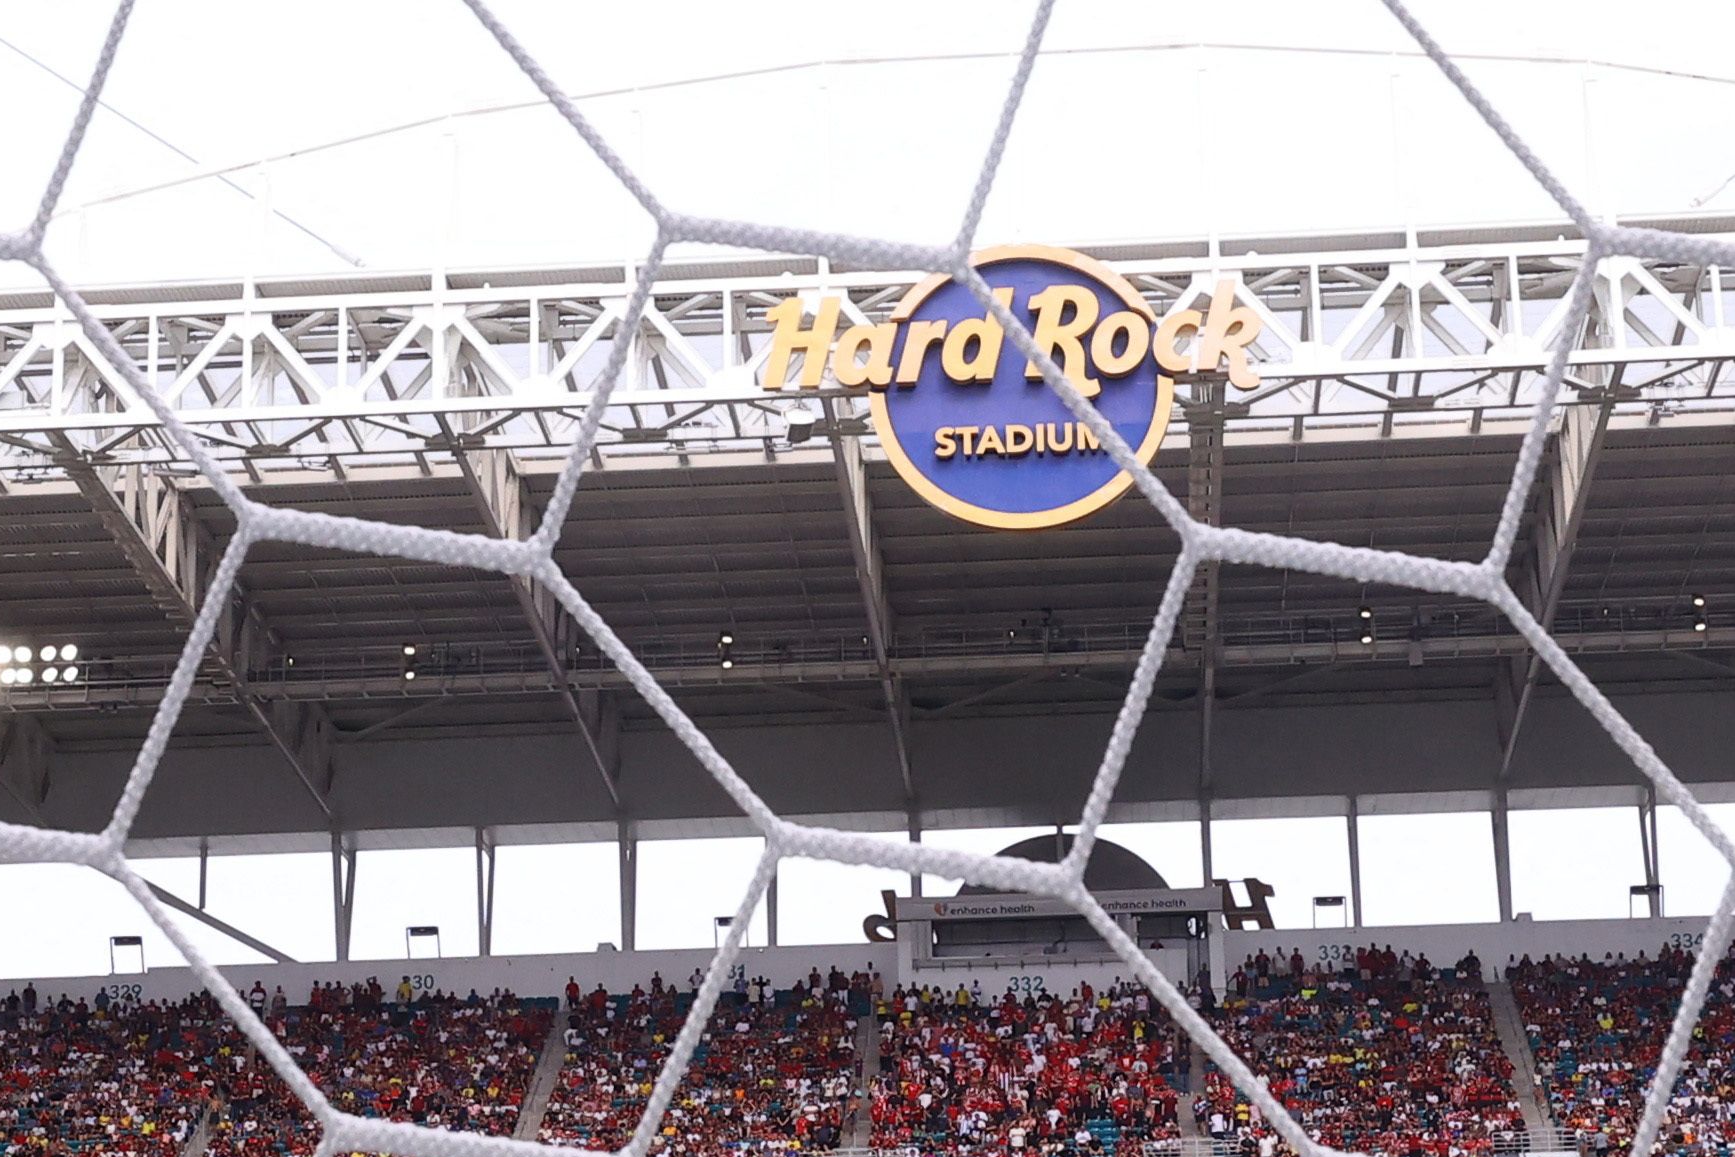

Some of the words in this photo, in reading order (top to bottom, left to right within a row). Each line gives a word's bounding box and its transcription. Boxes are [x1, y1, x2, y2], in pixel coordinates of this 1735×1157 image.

[763, 286, 1014, 391] Hard
[1023, 279, 1263, 398] Rock
[950, 904, 997, 916] enhance
[1001, 902, 1036, 915] health
[1150, 897, 1187, 910] health
[1009, 976, 1043, 991] 332
[110, 984, 143, 1000] 329
